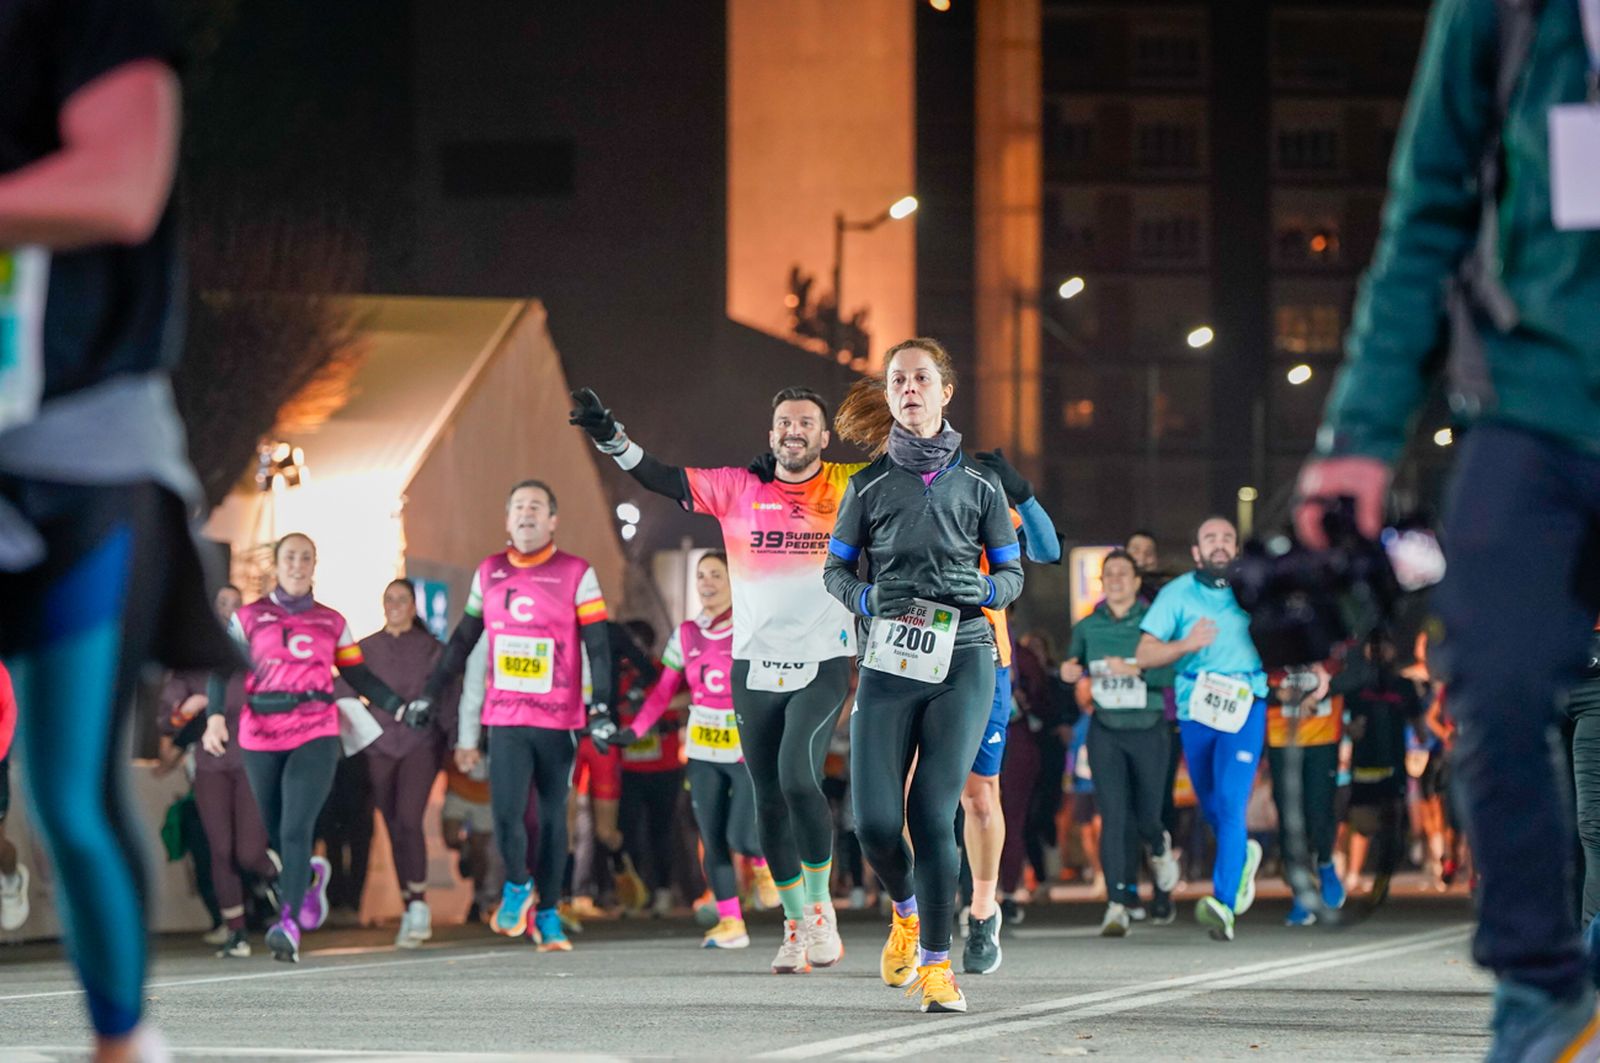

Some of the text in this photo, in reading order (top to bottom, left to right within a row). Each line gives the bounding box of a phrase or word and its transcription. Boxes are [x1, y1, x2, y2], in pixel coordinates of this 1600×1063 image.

[750, 531, 831, 548] 39 SUBIDA
[916, 608, 928, 617] DE
[505, 657, 541, 673] 8029
[1204, 692, 1237, 713] 4516
[698, 727, 731, 743] 7824
